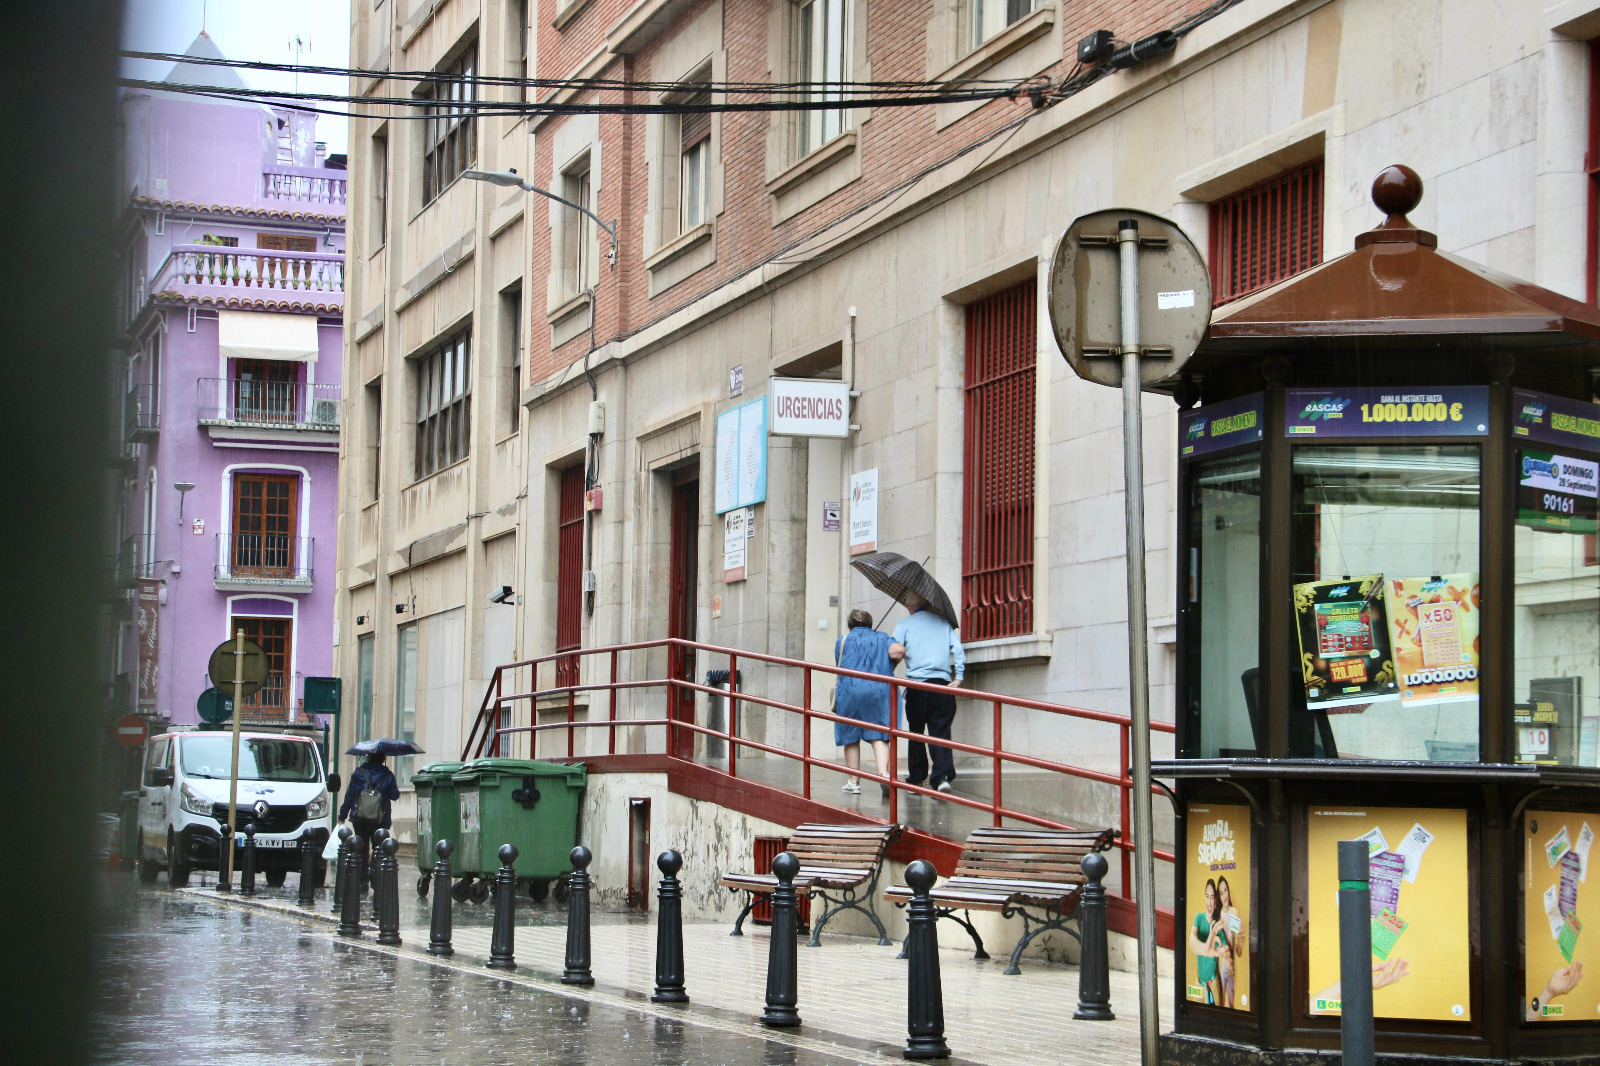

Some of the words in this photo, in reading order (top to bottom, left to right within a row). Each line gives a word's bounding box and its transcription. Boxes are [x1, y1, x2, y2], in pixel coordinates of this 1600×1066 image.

[1426, 394, 1443, 402] HASTA
[777, 395, 843, 421] URGENCIAS
[1305, 403, 1344, 412] RASCAS
[1360, 402, 1448, 423] 1.000.000
[1449, 402, 1463, 422] €
[1522, 405, 1543, 417] RASCAS
[1563, 464, 1593, 480] DOMINGO
[1558, 477, 1566, 487] 28
[1566, 479, 1597, 493] Septiembre
[1543, 493, 1575, 514] 90161
[1423, 608, 1453, 624] x50
[1529, 730, 1546, 745] 10
[1203, 819, 1229, 843] AHORA
[1198, 837, 1235, 866] SIEMPRE
[1220, 862, 1237, 871] JUGADO
[1382, 910, 1404, 930] x20
[1328, 1001, 1342, 1009] ON
[1548, 1006, 1563, 1014] ONCE
